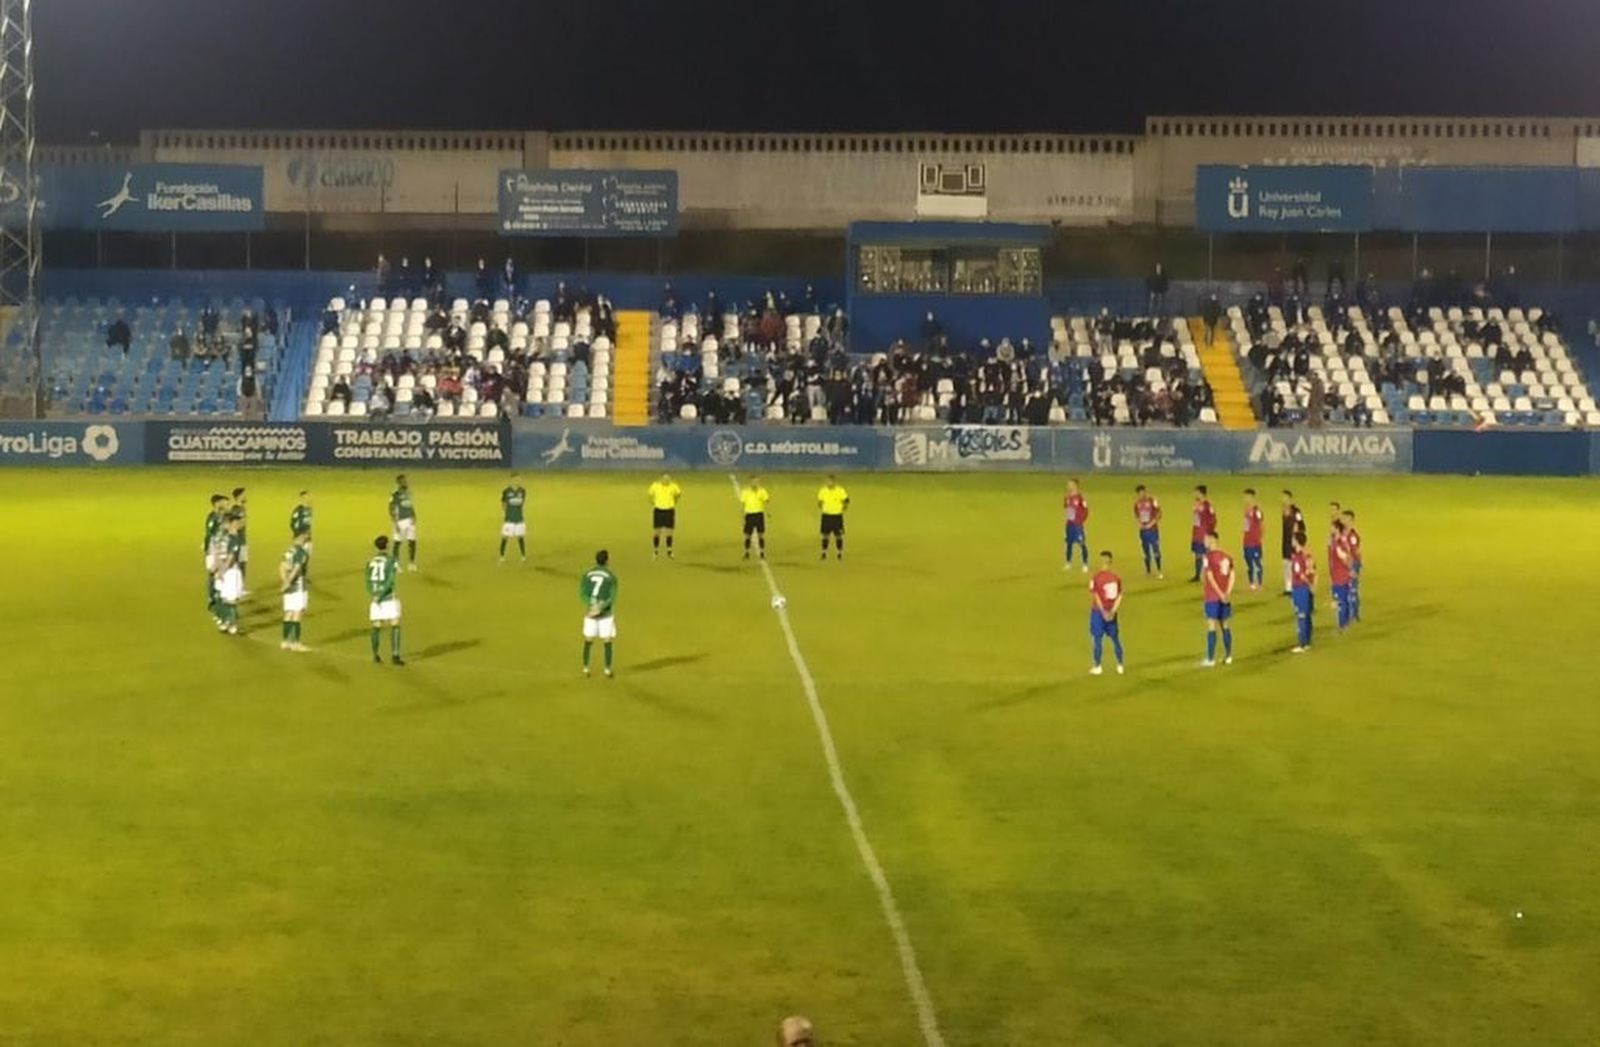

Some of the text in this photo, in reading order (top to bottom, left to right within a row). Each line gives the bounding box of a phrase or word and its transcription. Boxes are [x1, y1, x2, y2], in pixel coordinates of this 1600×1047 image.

[1259, 191, 1321, 202] Universidad
[1281, 206, 1305, 219] Juan
[168, 436, 307, 449] CUATROCAMINOS
[334, 427, 499, 445] TRABAJO PASIÓN
[771, 440, 839, 455] MÓSTOLES
[1293, 434, 1396, 455] ARRIAGA
[334, 447, 502, 459] CONSTANCIA Y VICTORIA
[370, 561, 385, 581] 21
[591, 576, 604, 597] 7
